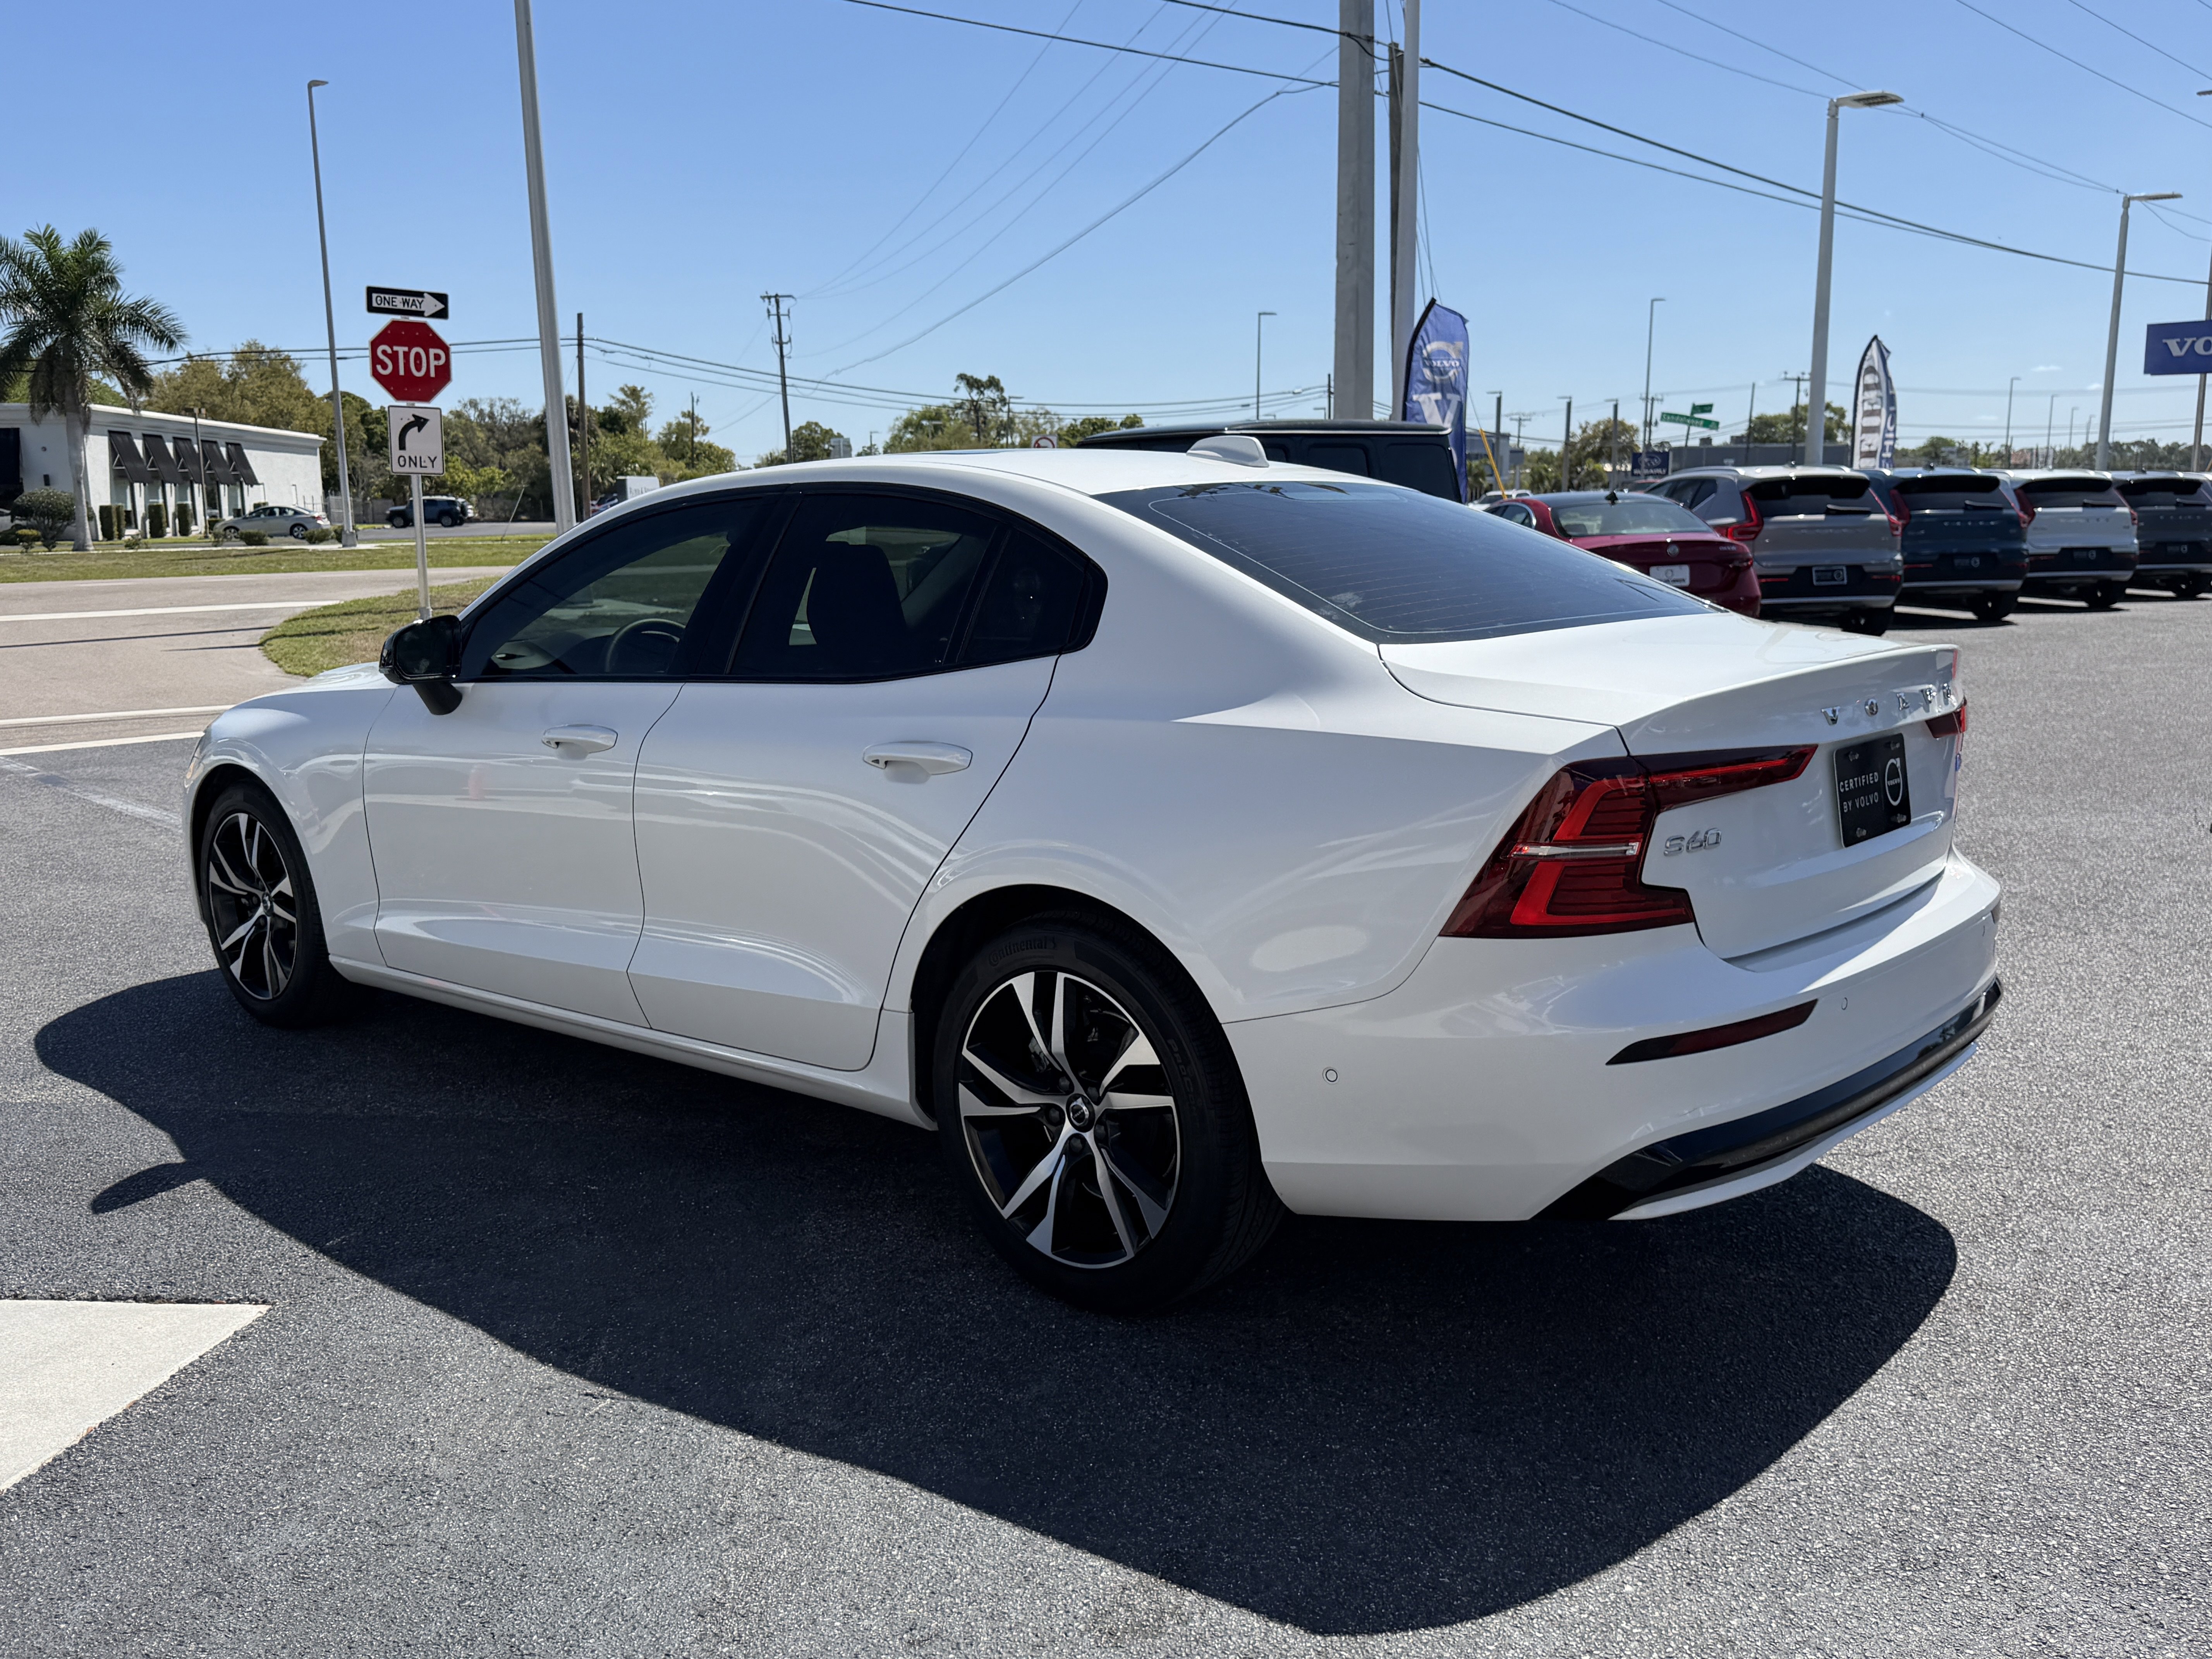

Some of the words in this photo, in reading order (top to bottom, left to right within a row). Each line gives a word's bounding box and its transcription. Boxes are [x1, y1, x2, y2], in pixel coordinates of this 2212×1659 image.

[375, 295, 398, 307] ONE
[402, 296, 424, 309] WAY
[376, 344, 446, 378] STOP
[1424, 359, 1460, 368] VOLVO
[398, 455, 437, 469] ONLY
[1839, 771, 1879, 793] CERTIFIED
[1843, 801, 1852, 813] BY
[1855, 792, 1879, 809] VOLVO
[1663, 827, 1722, 857] S60
